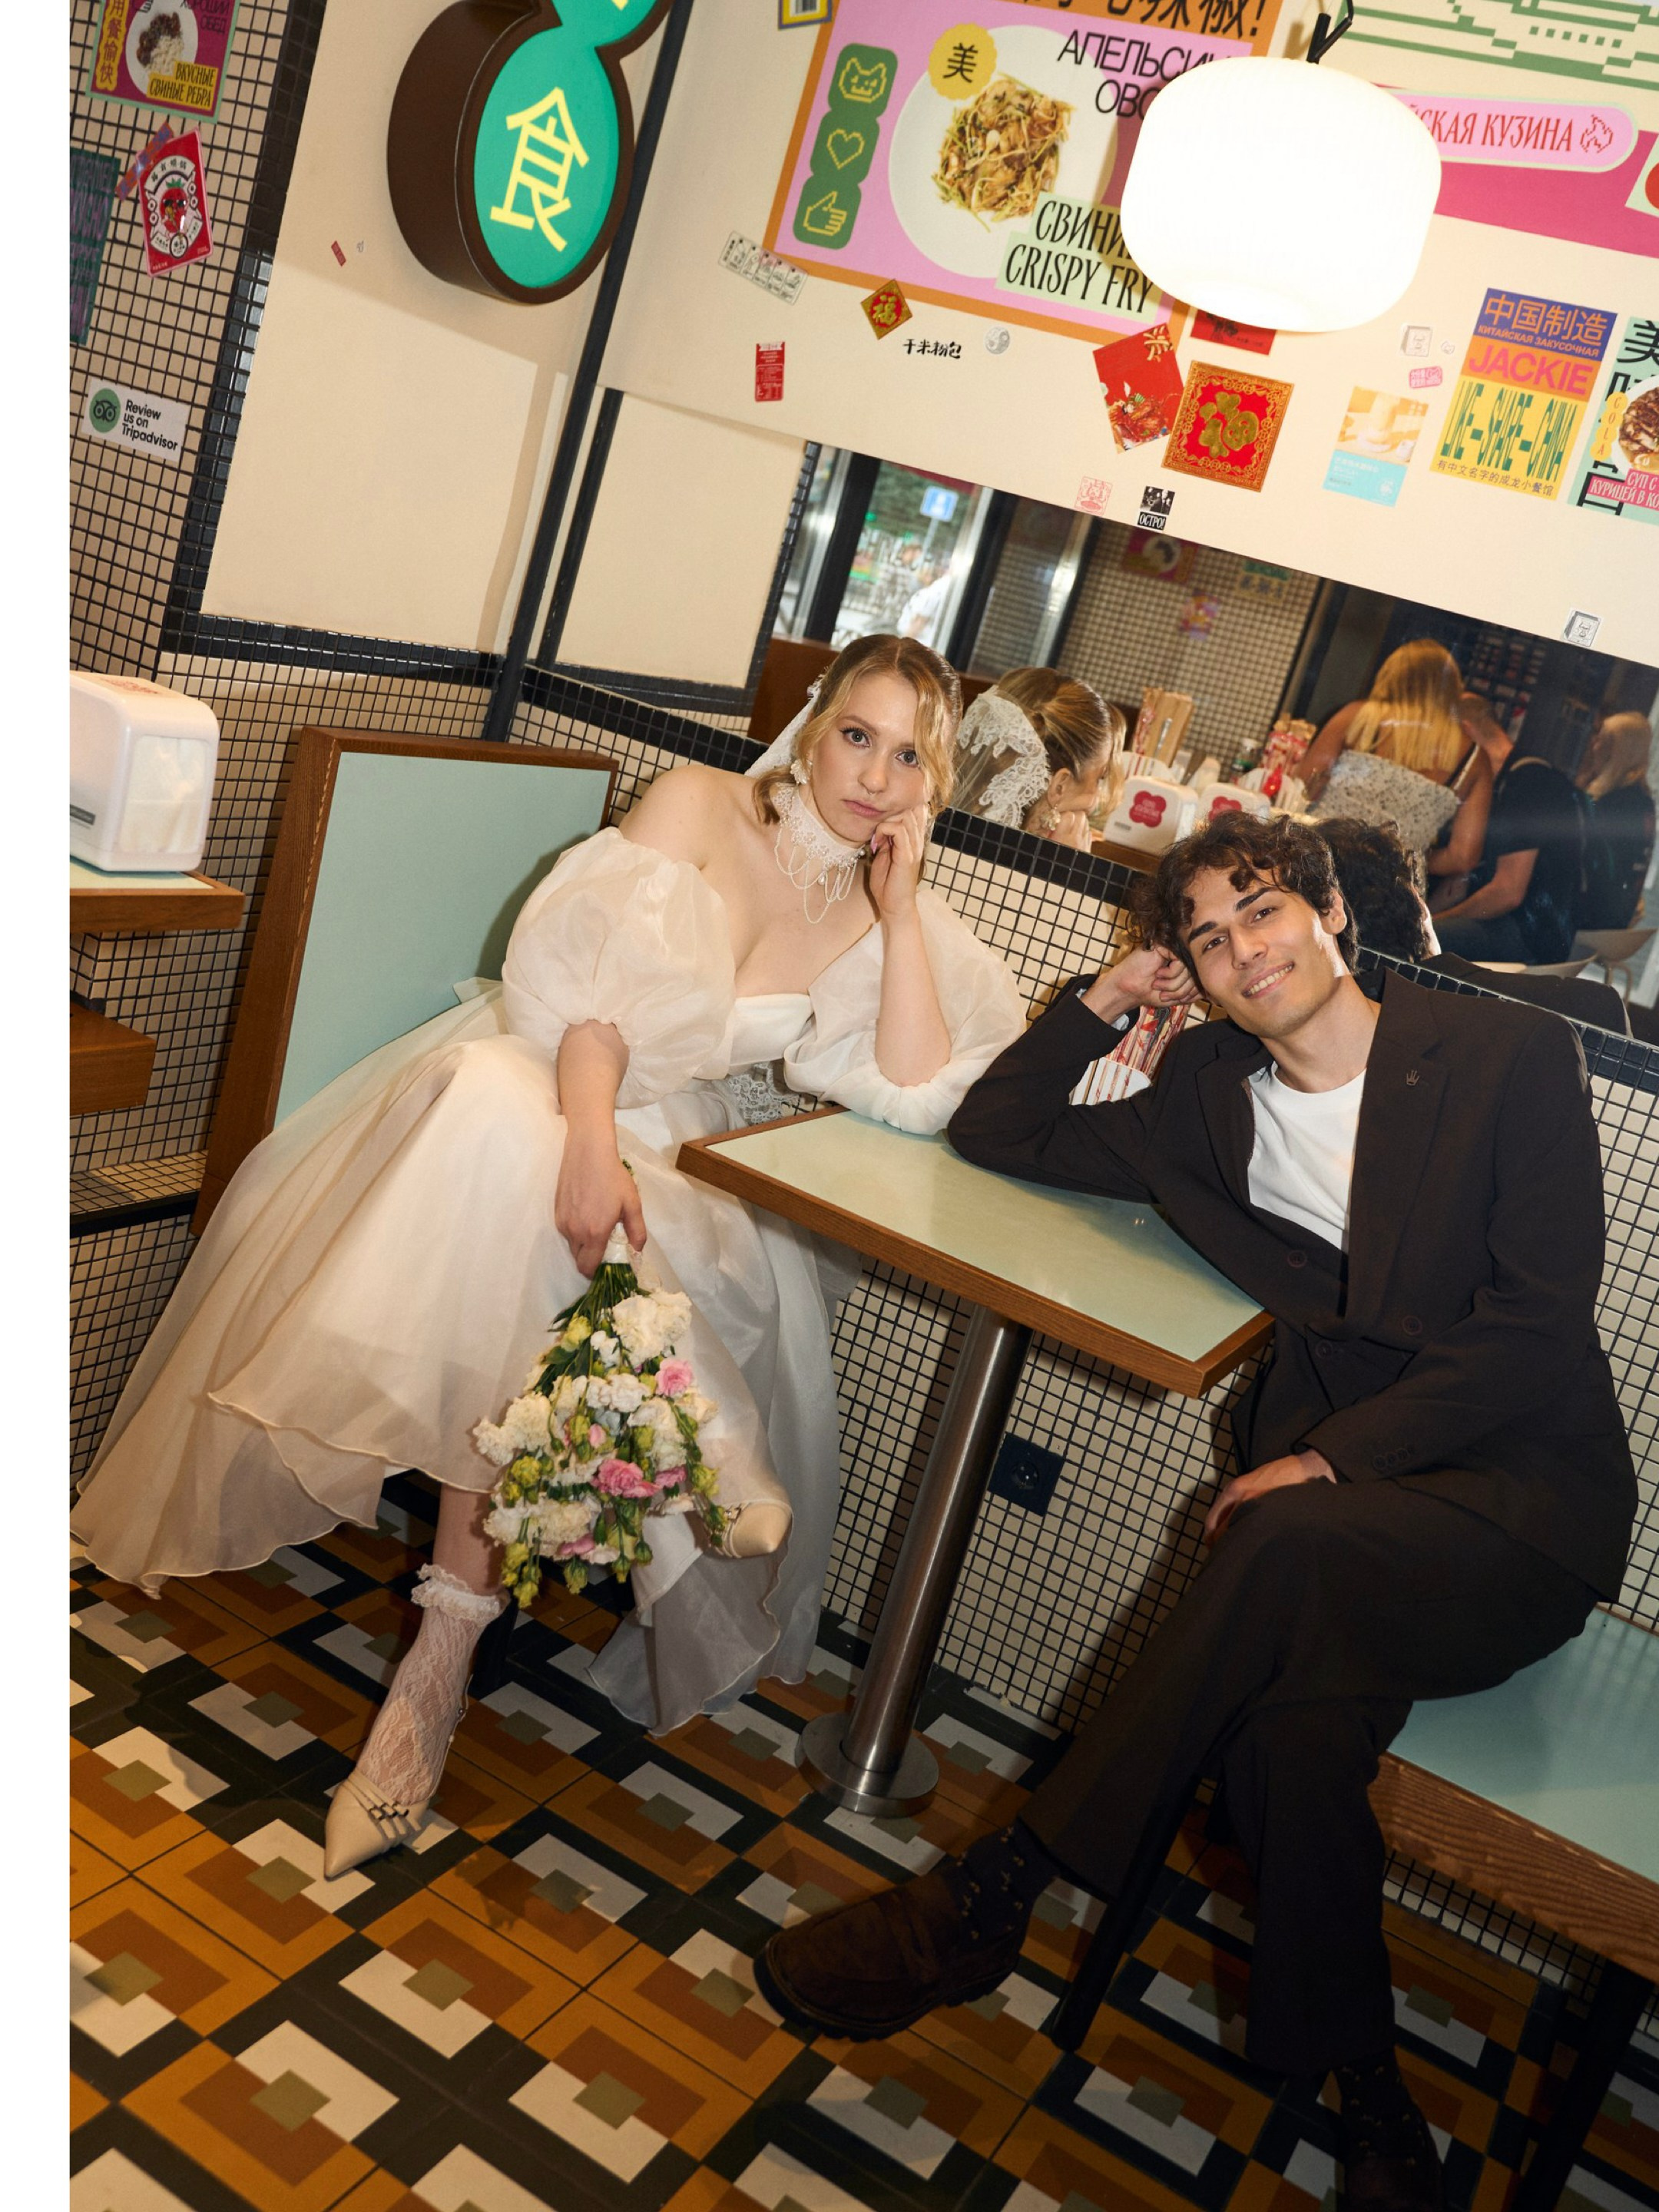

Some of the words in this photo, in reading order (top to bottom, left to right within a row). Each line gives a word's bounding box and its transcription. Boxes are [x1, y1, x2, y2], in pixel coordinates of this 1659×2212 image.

[942, 42, 979, 84] 美
[1056, 28, 1232, 81] АПЕЛЬСИ
[175, 62, 216, 87] ВКУСНЫЕ
[150, 78, 186, 101] СВИНЫЕ
[186, 85, 211, 107] РЕБРА
[1481, 113, 1575, 152] КУЗИНА
[489, 86, 589, 252] 食
[1035, 199, 1133, 260] СВИНИ
[1005, 243, 1104, 301] CRISPY
[1484, 293, 1608, 346] 中国制造
[1478, 323, 1534, 343] КИТАЙСКАЯ
[1534, 336, 1599, 358] ЗАКУСОЧНАЯ
[1469, 344, 1594, 396] JACKIE
[124, 413, 134, 424] us
[136, 417, 149, 429] on
[125, 399, 161, 420] Review
[122, 423, 178, 450] Tripadvisor
[1590, 478, 1637, 502] КУРИЦЕЙ
[1636, 490, 1645, 505] В
[1627, 471, 1649, 489] СУП
[1649, 476, 1658, 491] С
[1139, 513, 1166, 530] ОСТРО!
